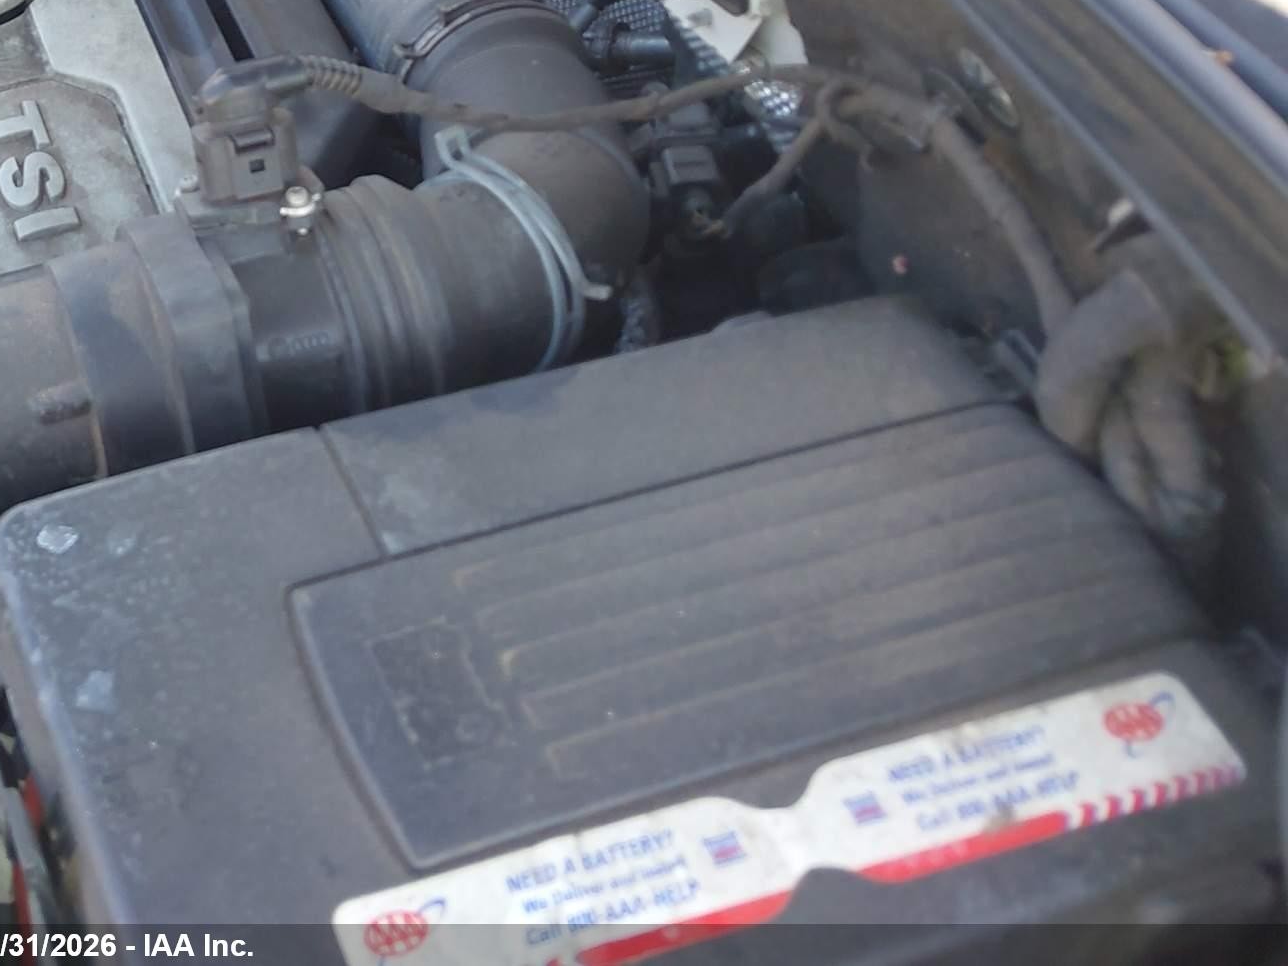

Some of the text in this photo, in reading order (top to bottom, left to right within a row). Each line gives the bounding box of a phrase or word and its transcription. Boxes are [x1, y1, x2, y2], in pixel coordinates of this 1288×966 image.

[506, 863, 556, 891] NEED
[563, 857, 576, 874] A
[525, 925, 562, 945] Call
